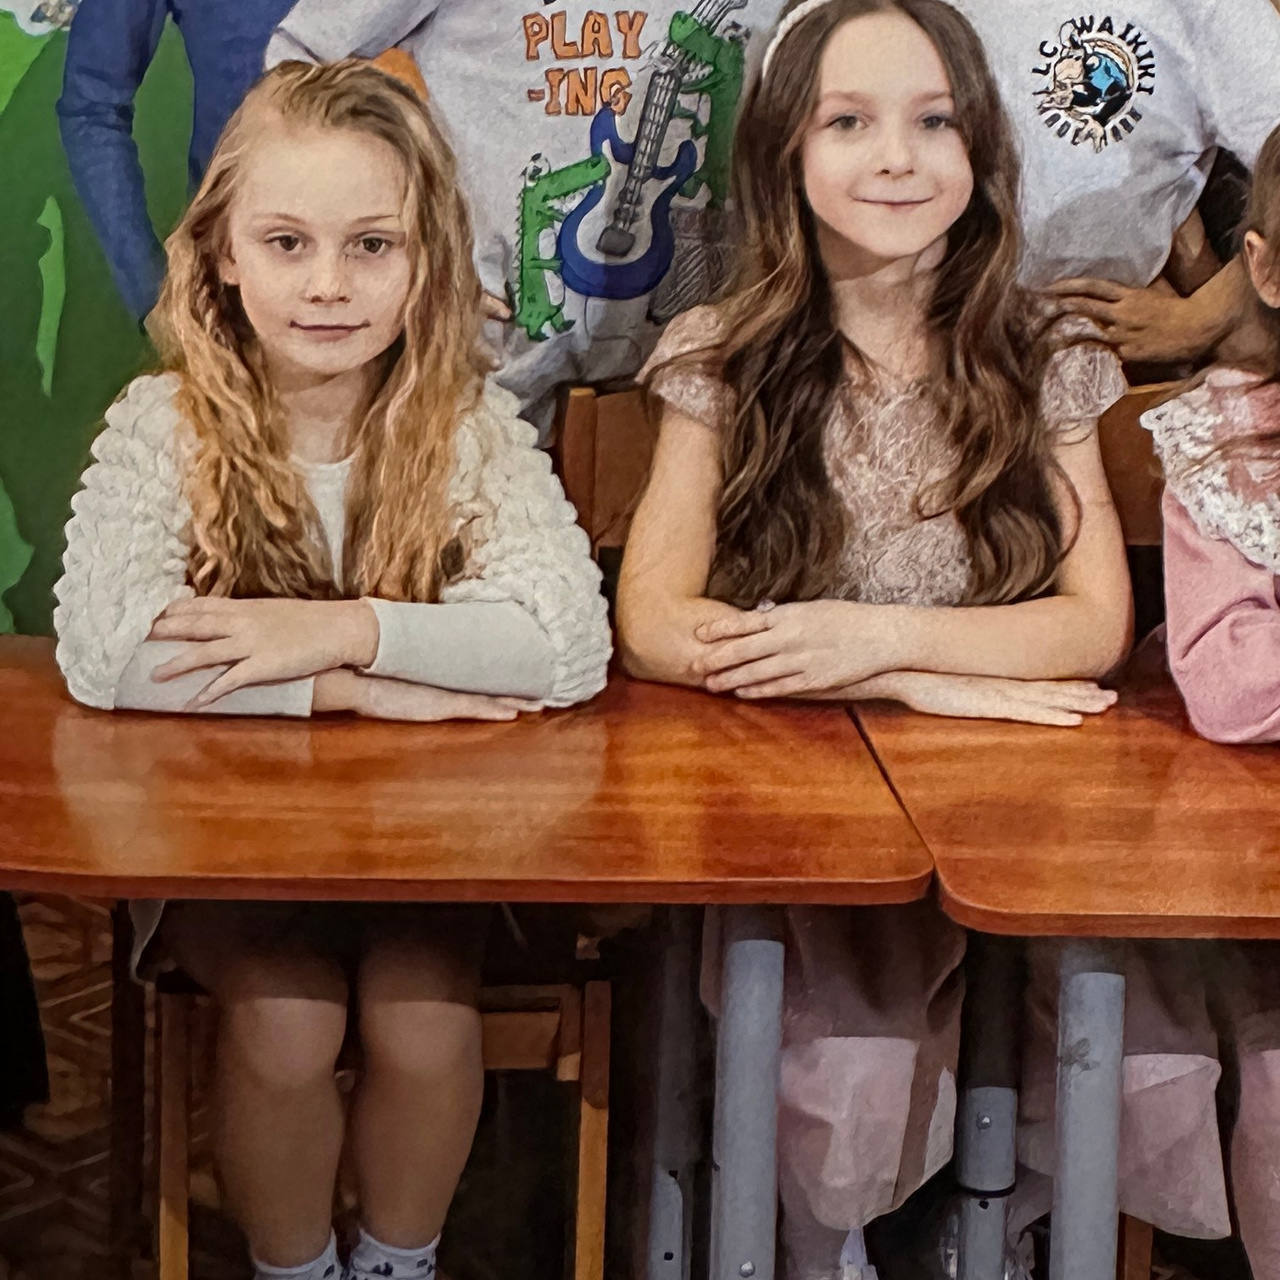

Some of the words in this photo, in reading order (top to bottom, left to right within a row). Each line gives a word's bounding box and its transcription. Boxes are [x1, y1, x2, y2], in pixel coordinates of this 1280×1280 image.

[521, 10, 649, 61] PLAY
[1070, 14, 1156, 96] WAIKIKI
[526, 66, 633, 117] -ING
